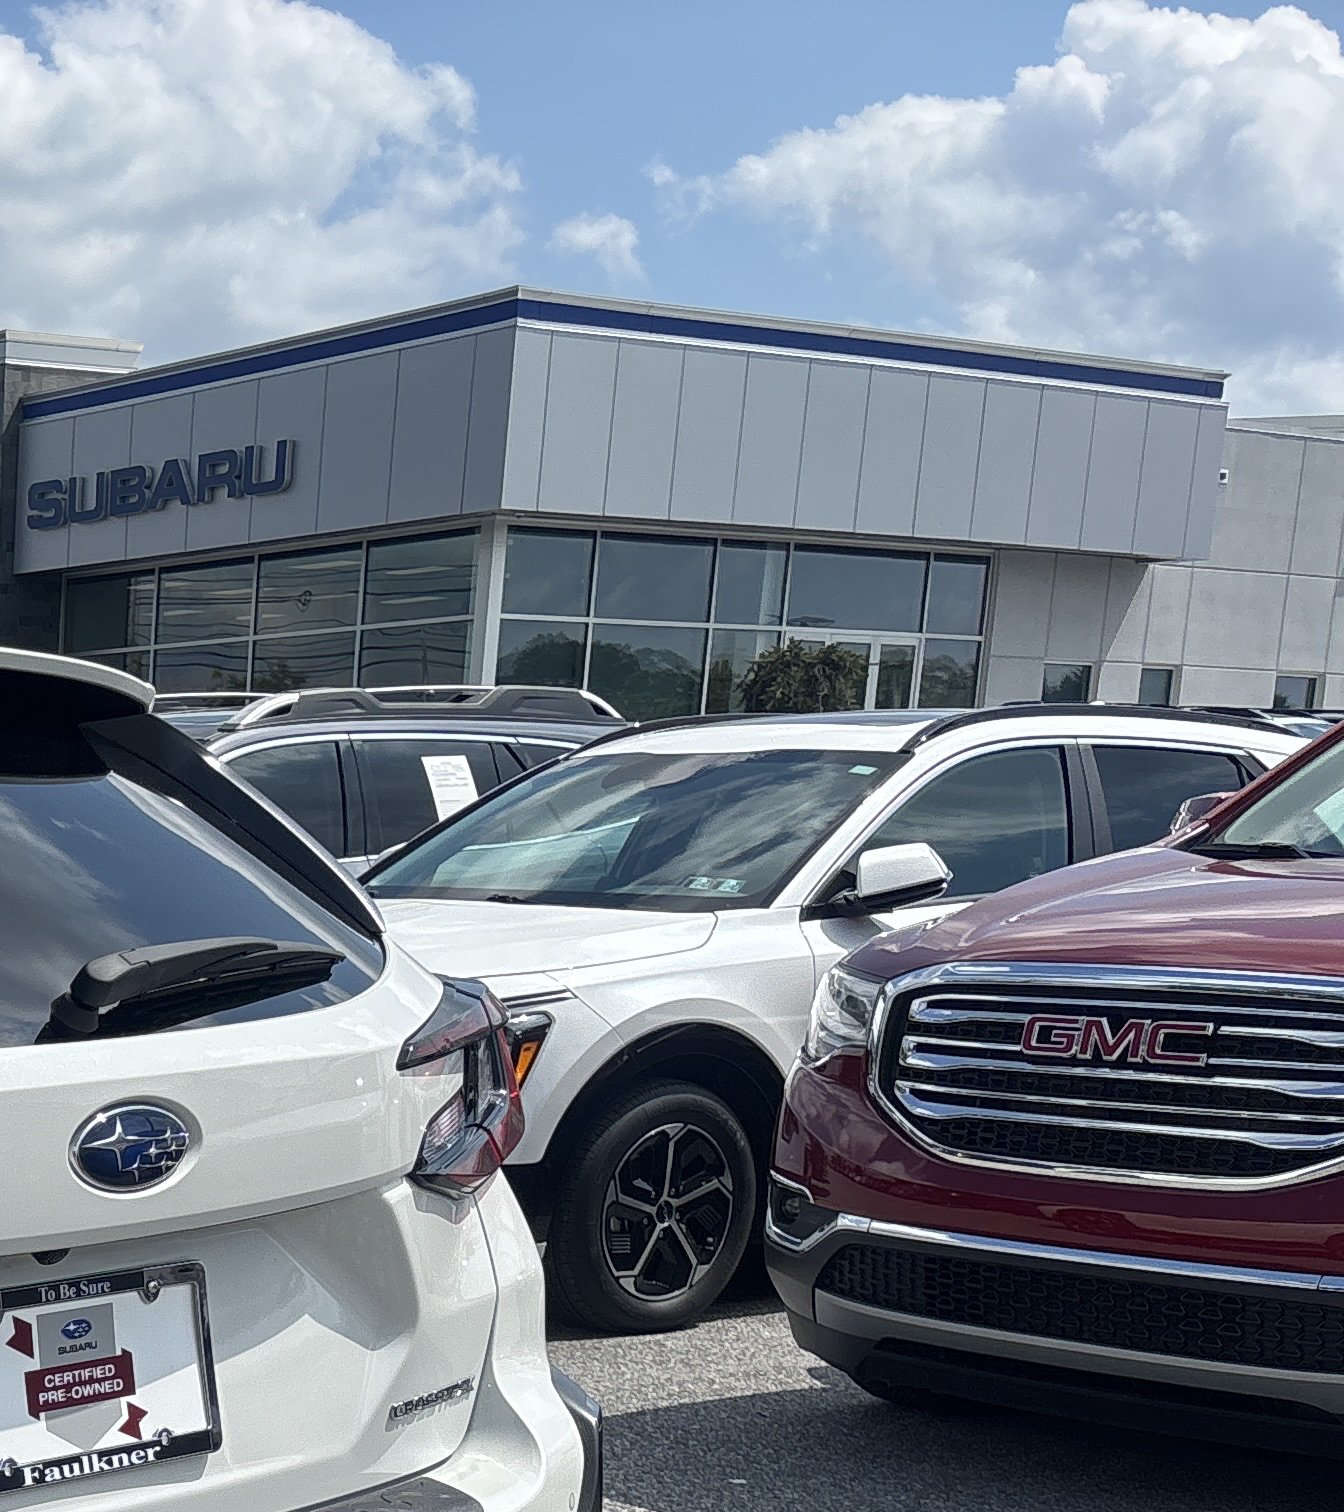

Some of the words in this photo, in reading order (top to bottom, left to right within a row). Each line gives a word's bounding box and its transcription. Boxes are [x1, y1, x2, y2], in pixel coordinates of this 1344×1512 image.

[26, 439, 296, 530] SUBARU
[1021, 1014, 1214, 1067] GMC
[38, 1286, 56, 1303] To
[60, 1284, 77, 1299] Be
[79, 1280, 112, 1297] Sure
[57, 1341, 98, 1355] SUBARU
[44, 1364, 115, 1388] CERTIFIED
[38, 1379, 124, 1405] PRE-OWNED
[20, 1444, 162, 1487] Faulkner
